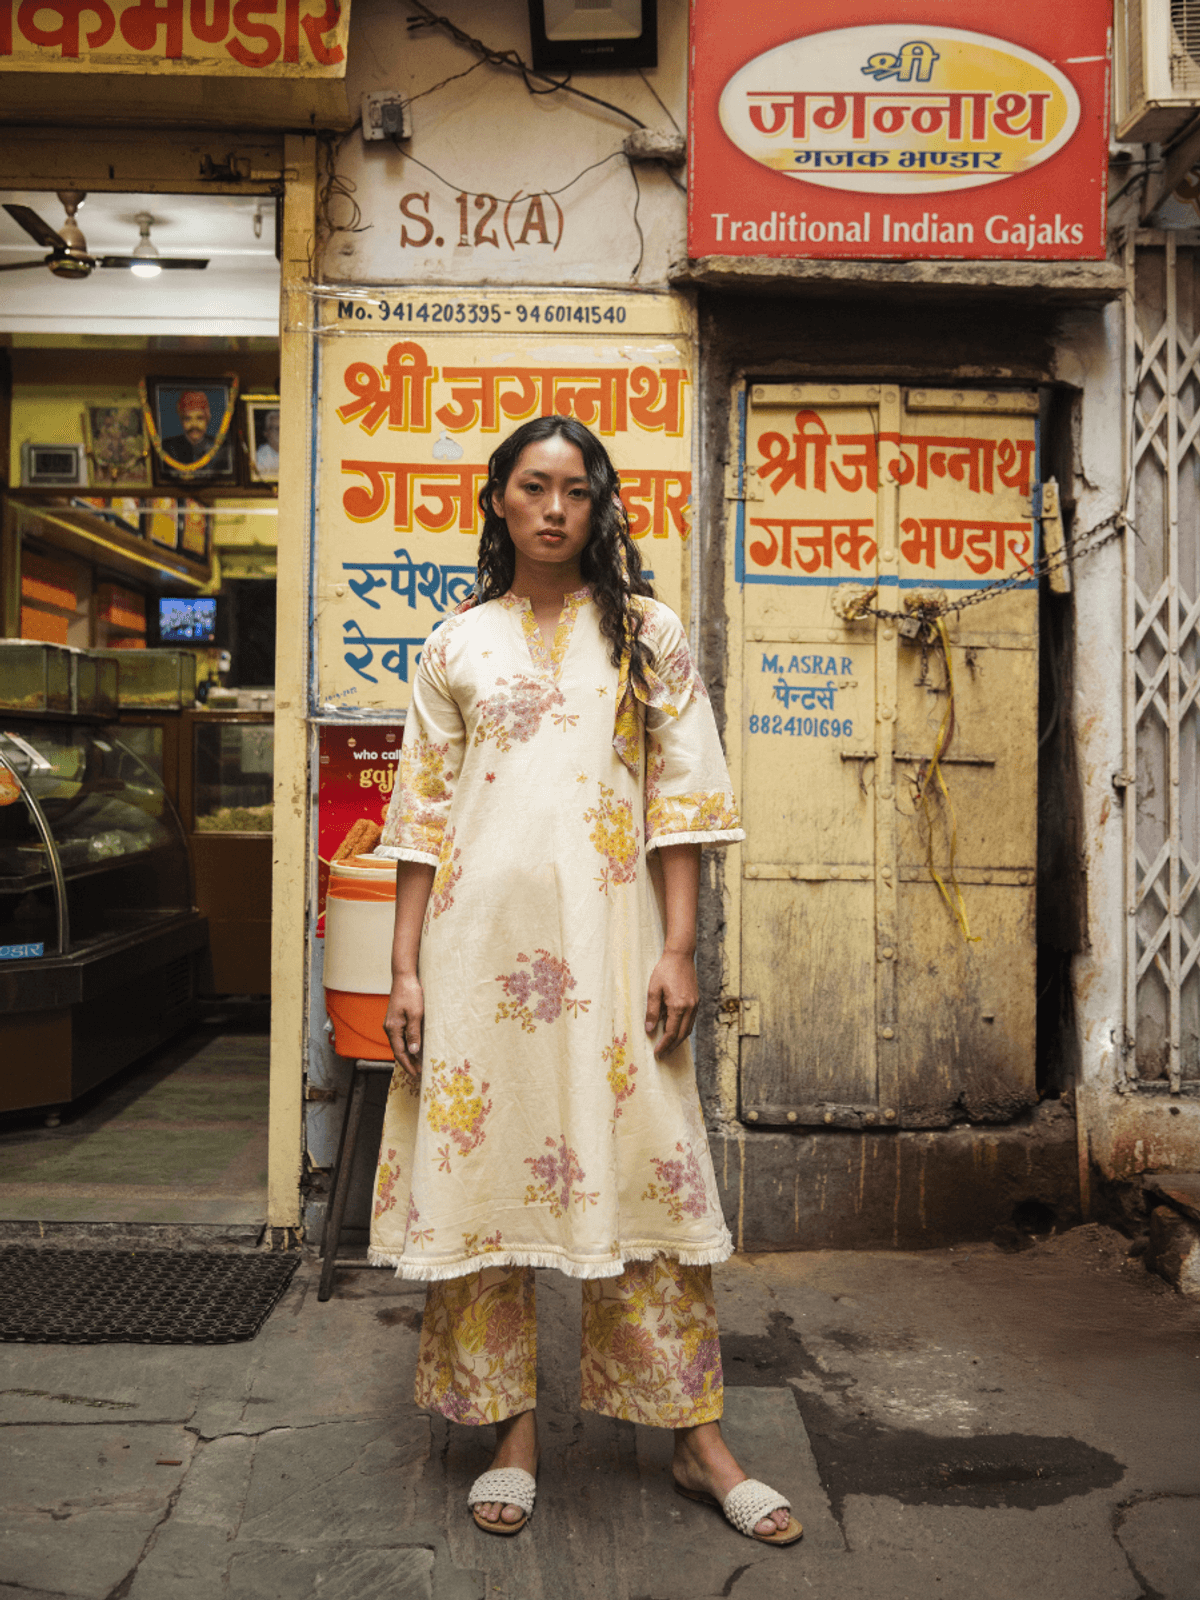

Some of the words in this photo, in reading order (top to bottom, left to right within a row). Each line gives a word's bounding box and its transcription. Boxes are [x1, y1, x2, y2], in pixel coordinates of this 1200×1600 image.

[860, 41, 940, 82] श्री
[746, 91, 1051, 142] जगन्नाथ
[794, 150, 889, 168] गजक
[897, 151, 1003, 169] भण्डार
[711, 212, 871, 243] Traditional
[883, 212, 974, 244] Indian
[985, 214, 1084, 251] Gajaks
[337, 301, 373, 321] Mo.
[335, 341, 439, 437] श्री
[756, 409, 832, 496] श्री
[341, 459, 492, 535] गज
[749, 517, 878, 574] गजक
[899, 517, 1035, 576] भण्डार
[772, 677, 838, 711] पेन्टर्स
[748, 714, 853, 738] 8824101696
[353, 749, 378, 760] who
[359, 762, 398, 794] gaj
